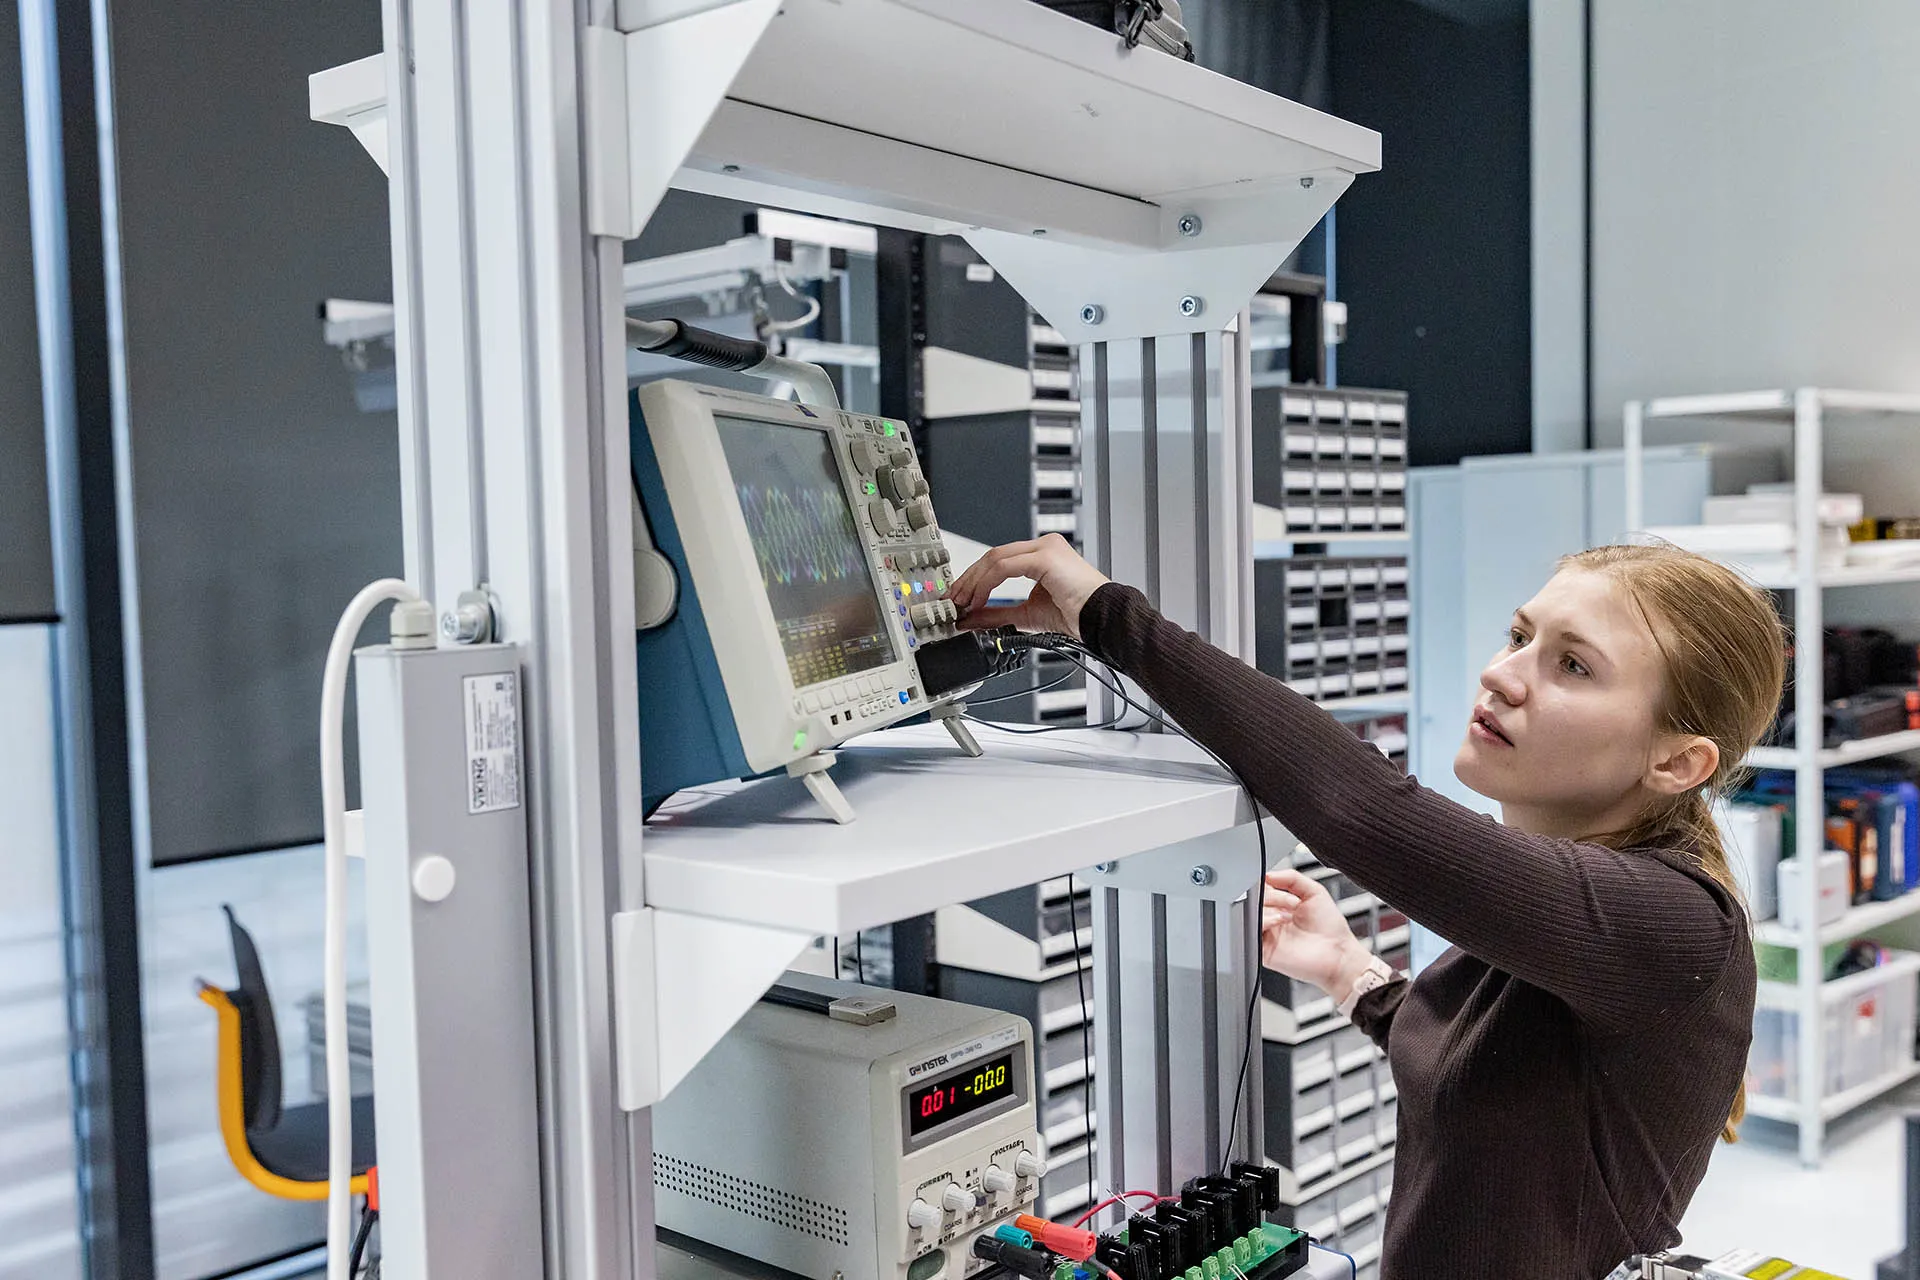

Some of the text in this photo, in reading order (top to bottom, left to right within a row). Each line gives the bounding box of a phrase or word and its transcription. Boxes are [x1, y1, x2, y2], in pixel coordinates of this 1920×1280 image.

[473, 758, 487, 809] VIKING
[994, 1139, 1020, 1156] VOLTAGE
[919, 1171, 949, 1190] CURRENT
[973, 1177, 979, 1185] LO
[996, 1207, 1008, 1218] GND
[943, 1232, 955, 1243] OFF
[922, 1244, 932, 1253] ON
